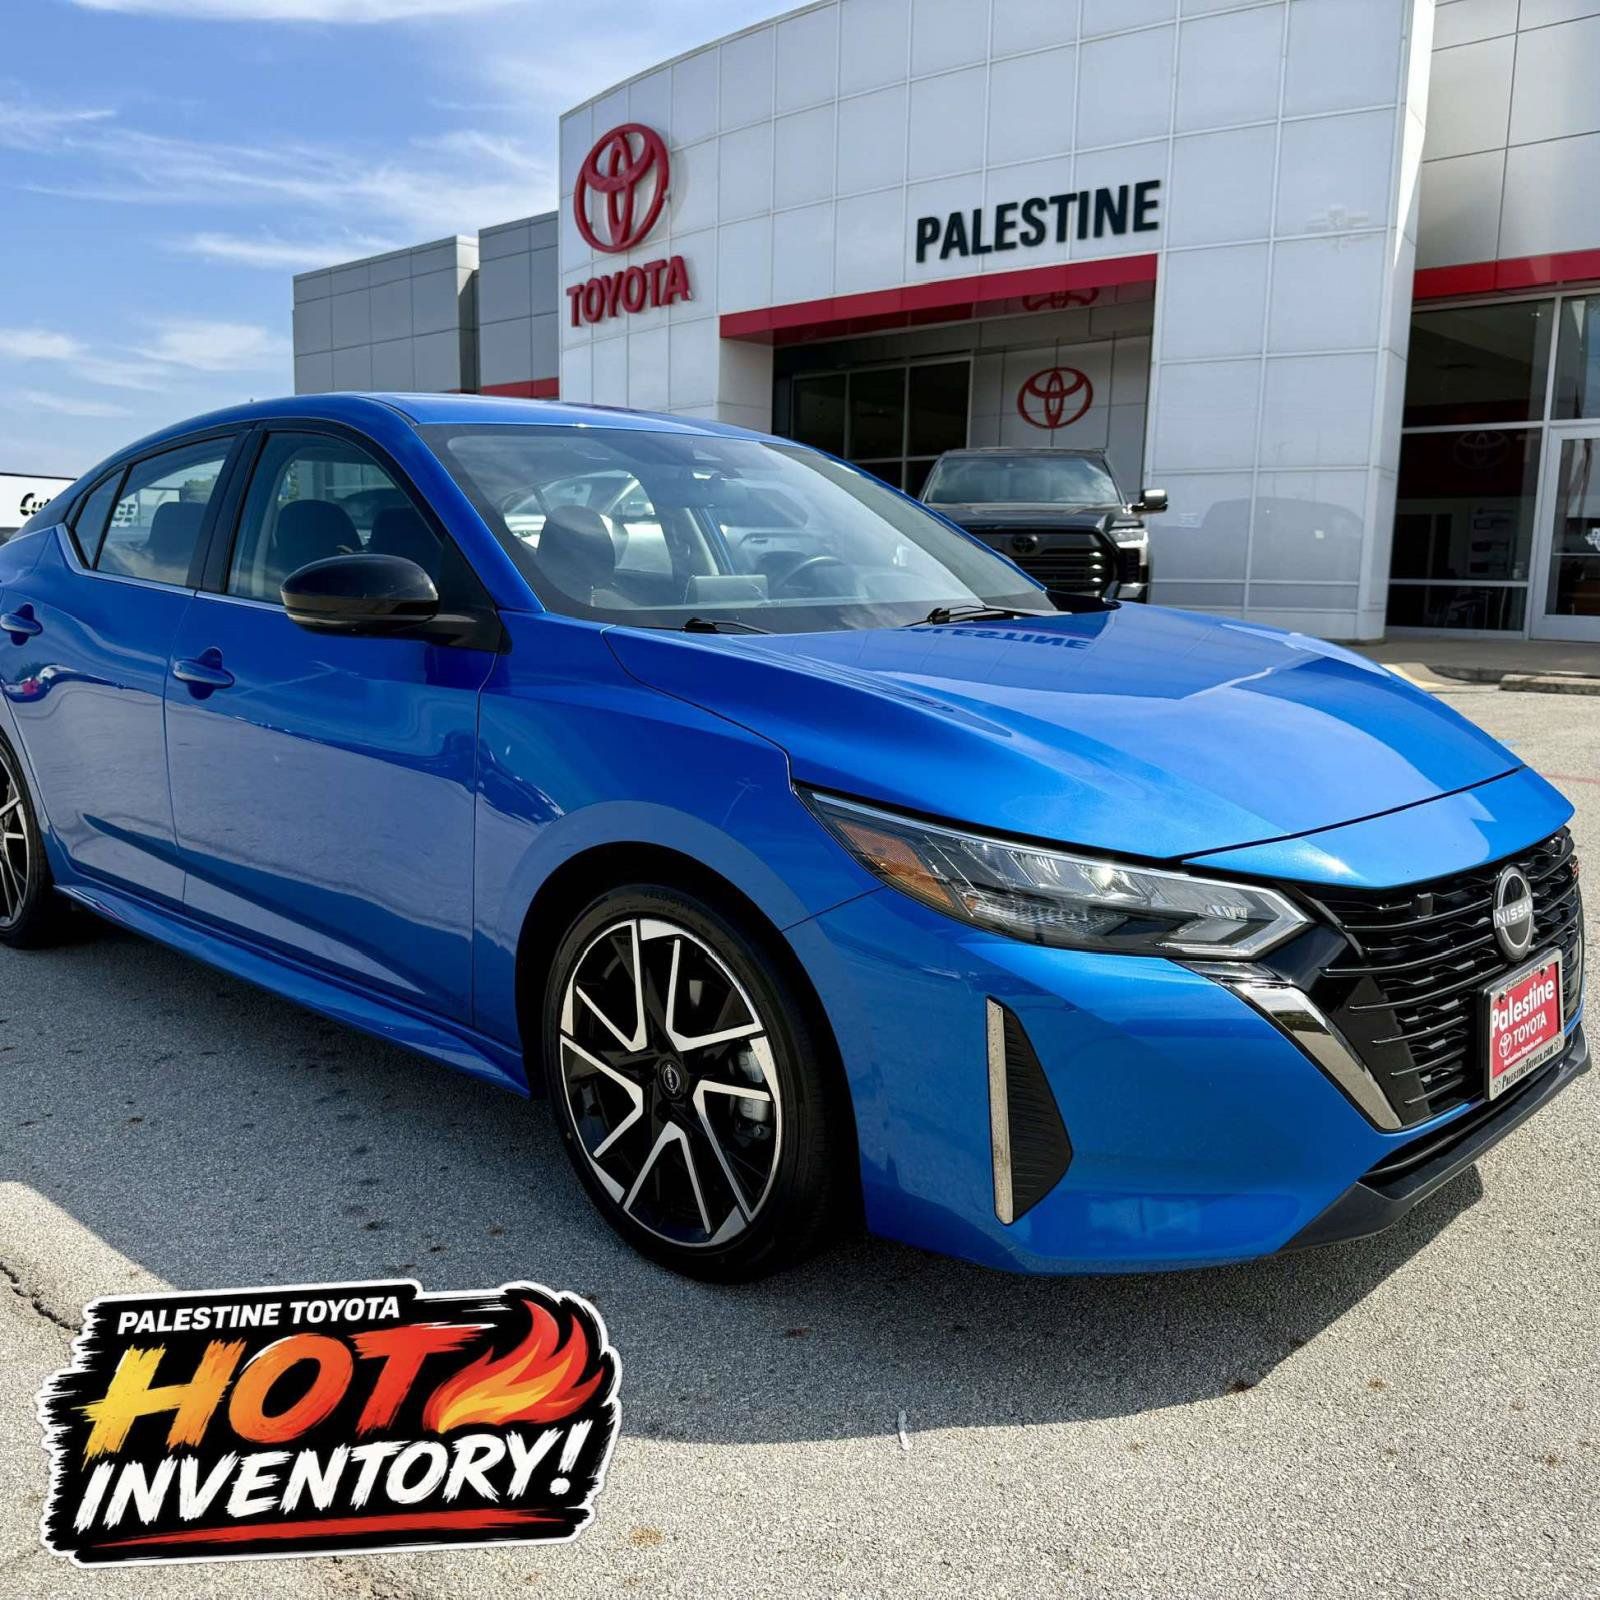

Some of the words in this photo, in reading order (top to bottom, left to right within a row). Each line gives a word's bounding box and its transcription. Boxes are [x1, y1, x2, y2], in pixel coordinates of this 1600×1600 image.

[916, 180, 1161, 262] PALESTINE
[567, 255, 692, 327] TOYOTA
[1490, 980, 1555, 1039] Palestine
[1513, 1010, 1548, 1046] TOYOTA
